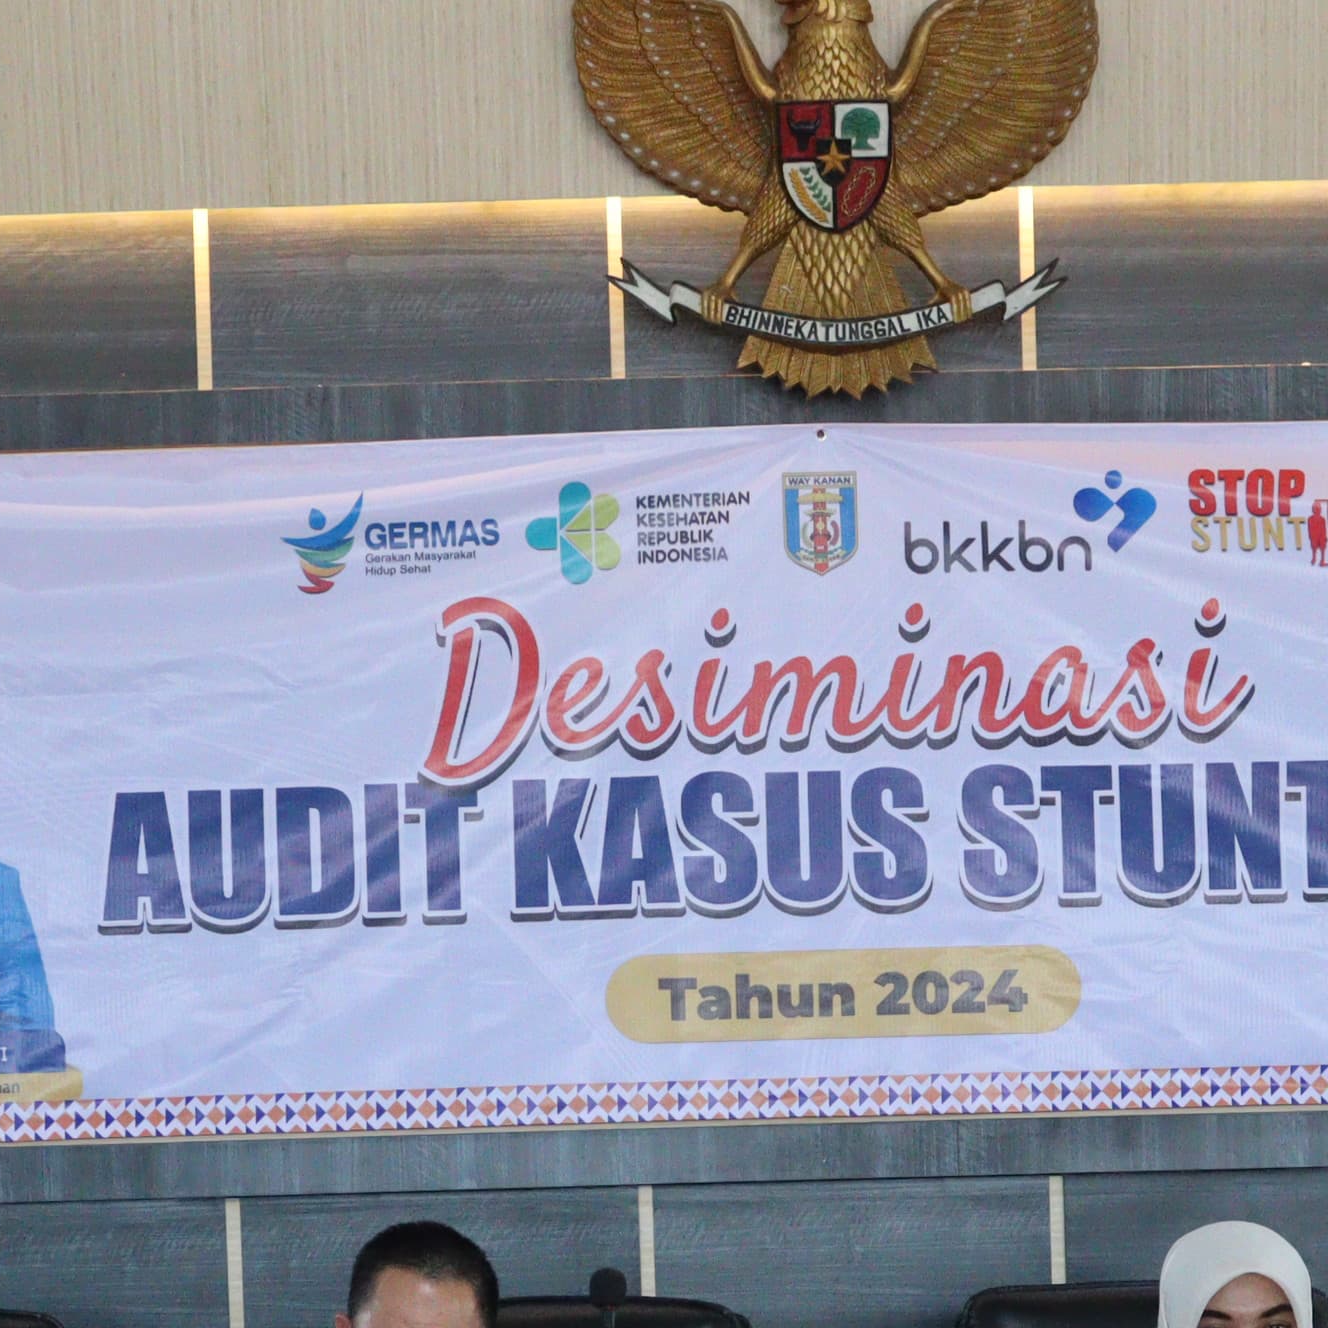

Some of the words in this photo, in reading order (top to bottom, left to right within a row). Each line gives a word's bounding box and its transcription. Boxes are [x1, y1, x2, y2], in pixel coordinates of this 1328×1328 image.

[725, 305, 819, 340] BHINNEKA
[822, 317, 911, 341] TUNGGAL
[916, 304, 950, 331] IKA
[787, 476, 810, 485] WAY
[813, 476, 851, 485] KANAN
[1187, 468, 1307, 517] STOP
[636, 491, 751, 509] KEMENTERIAN
[636, 511, 730, 528] KESEHATAN
[364, 518, 500, 550] GERMAS
[637, 530, 714, 547] REPUBLIK
[365, 552, 411, 563] Gerakan
[414, 550, 476, 562] Masyarakat
[637, 547, 729, 565] INDONESIA
[904, 520, 1092, 574] bkkbn
[365, 564, 397, 576] Hidup
[400, 563, 432, 574] Sehat
[422, 595, 1252, 783] Desiminasi
[99, 783, 480, 931] AUDIT
[511, 767, 932, 922] KASUS
[657, 973, 856, 1022] Tahun
[873, 969, 1029, 1016] 2024
